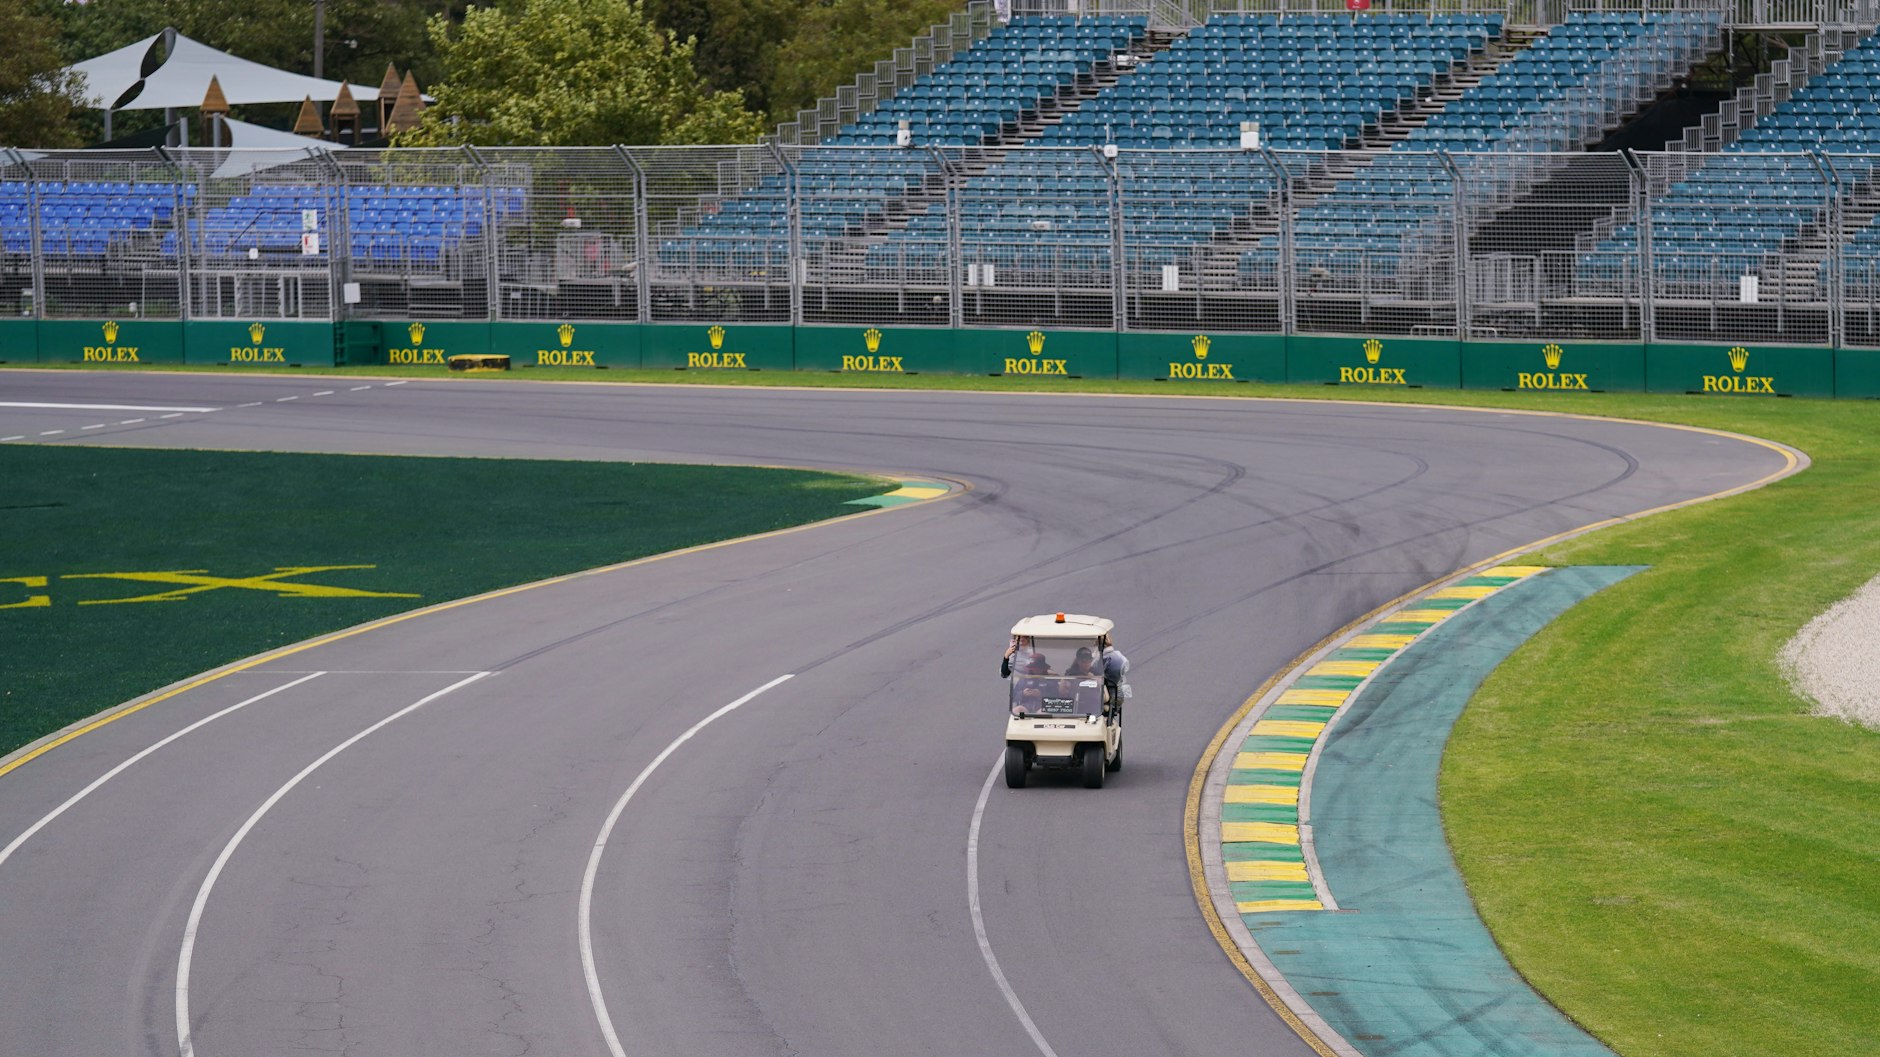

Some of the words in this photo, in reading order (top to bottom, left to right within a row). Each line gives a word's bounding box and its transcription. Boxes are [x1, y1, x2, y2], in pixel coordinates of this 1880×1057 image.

[84, 347, 139, 362] ROLEX
[230, 348, 285, 362] ROLEX
[389, 349, 445, 364] ROLEX
[538, 350, 595, 366] ROLEX
[688, 352, 746, 368] ROLEX
[843, 355, 903, 372] ROLEX
[1005, 358, 1067, 375] ROLEX
[1170, 362, 1233, 379] ROLEX
[1340, 367, 1406, 384] ROLEX
[1519, 373, 1588, 390] ROLEX
[1703, 375, 1775, 394] ROLEX
[0, 565, 421, 609] X
